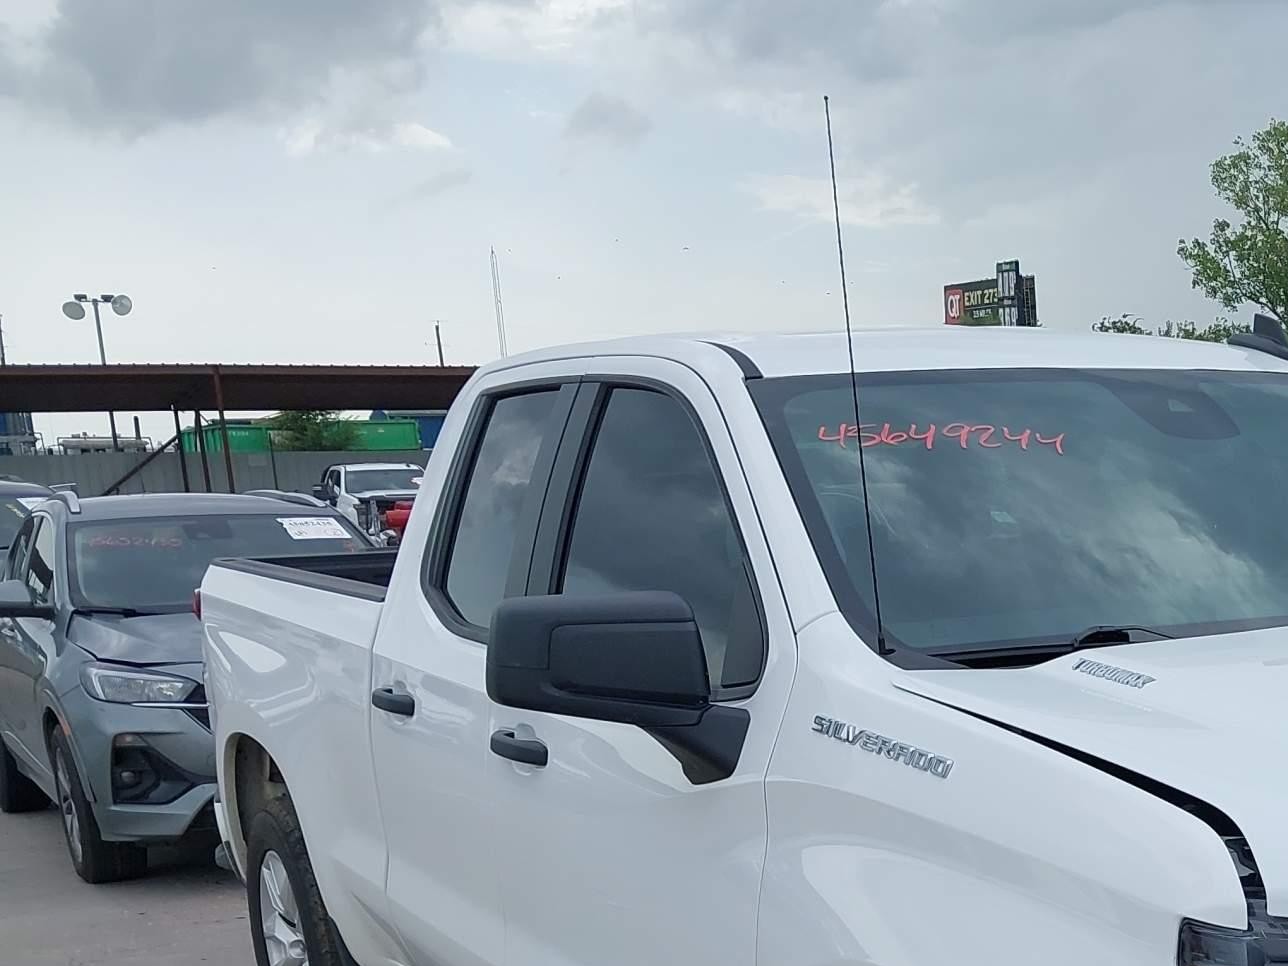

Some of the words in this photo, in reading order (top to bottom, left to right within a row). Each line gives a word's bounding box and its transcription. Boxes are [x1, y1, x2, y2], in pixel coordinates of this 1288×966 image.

[948, 295, 960, 318] QT
[964, 290, 982, 306] EXIT
[984, 288, 999, 304] 273
[818, 422, 1065, 455] 45649244
[1071, 657, 1157, 689] TURBOMAX
[811, 714, 956, 779] SILVERADO
